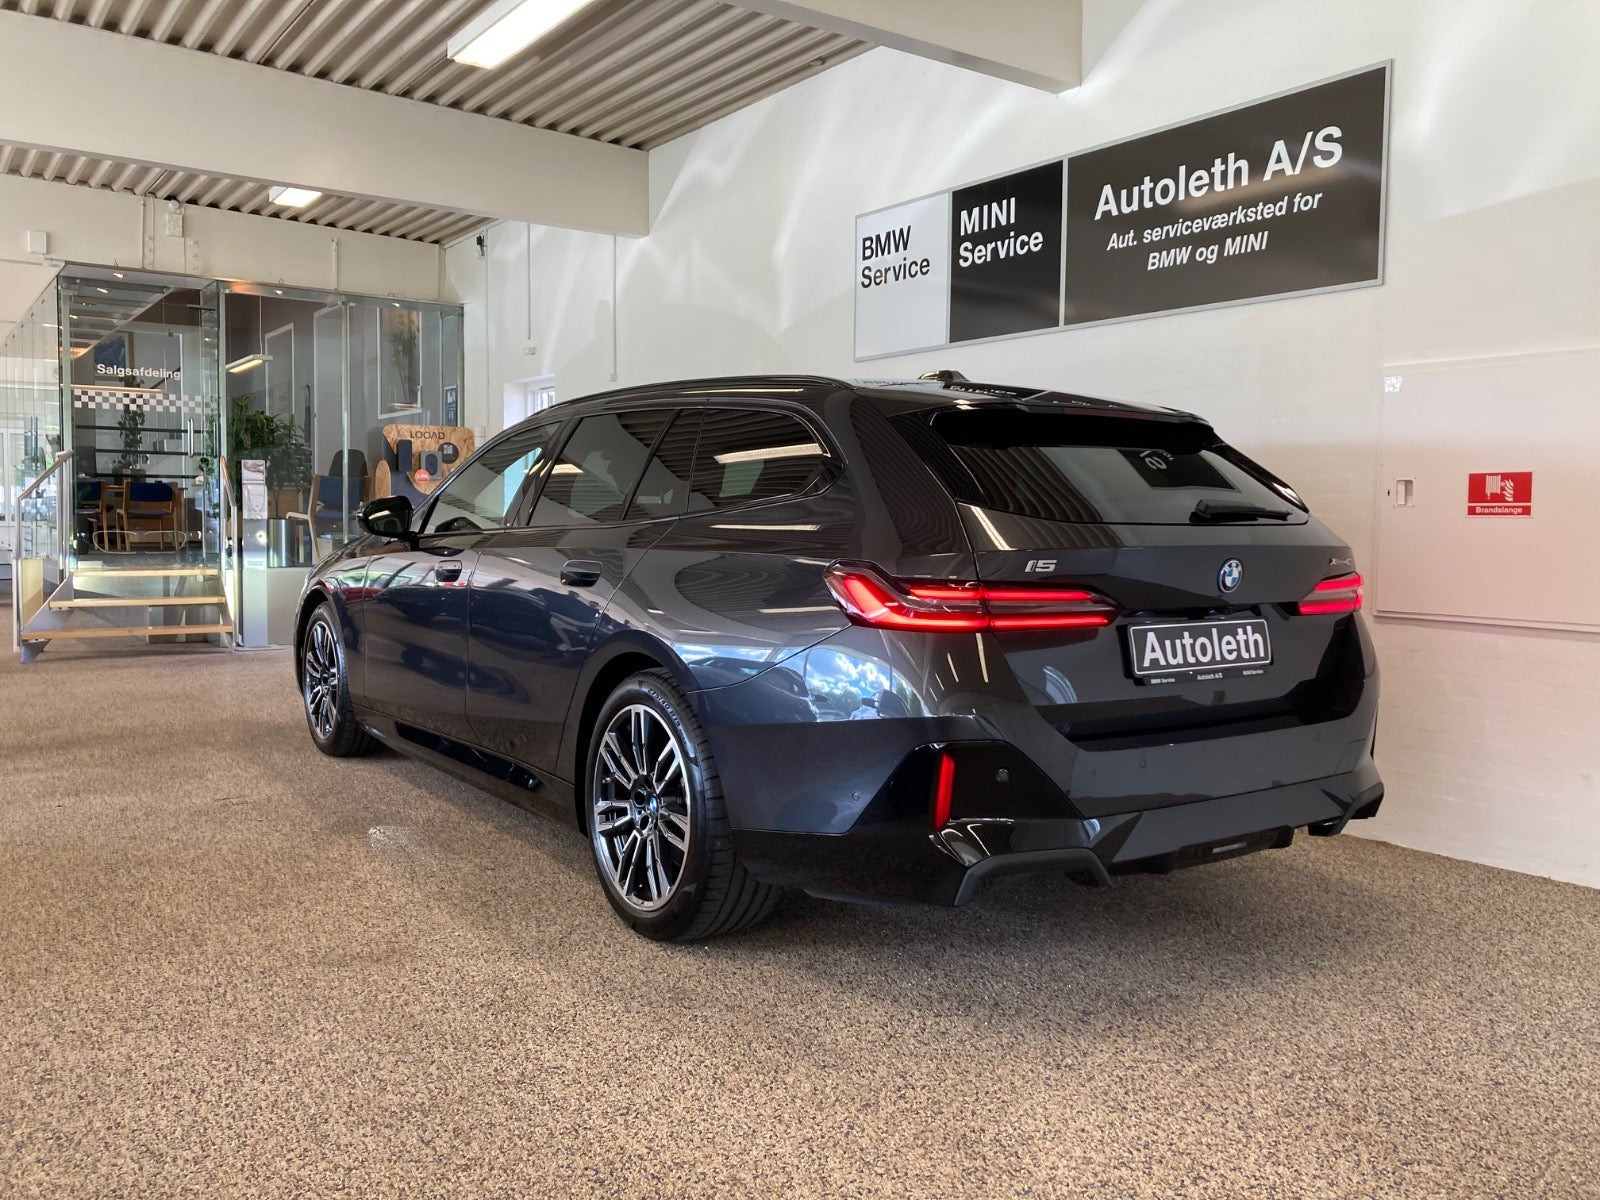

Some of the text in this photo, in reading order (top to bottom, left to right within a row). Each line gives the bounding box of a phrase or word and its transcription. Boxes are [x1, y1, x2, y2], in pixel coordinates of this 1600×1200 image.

[1094, 126, 1343, 221] Autoleth A/S
[959, 197, 1016, 237] MINI
[1106, 191, 1323, 251] Aut. serviceværksted for
[861, 225, 911, 261] BMW
[958, 230, 1044, 268] Service
[1146, 231, 1267, 272] BMW og MINI
[860, 257, 931, 288] Service
[97, 364, 181, 380] Salgsafdeling
[410, 430, 445, 440] LOOAD
[1475, 506, 1523, 515] Brandslange
[1143, 625, 1265, 667] Autoleth
